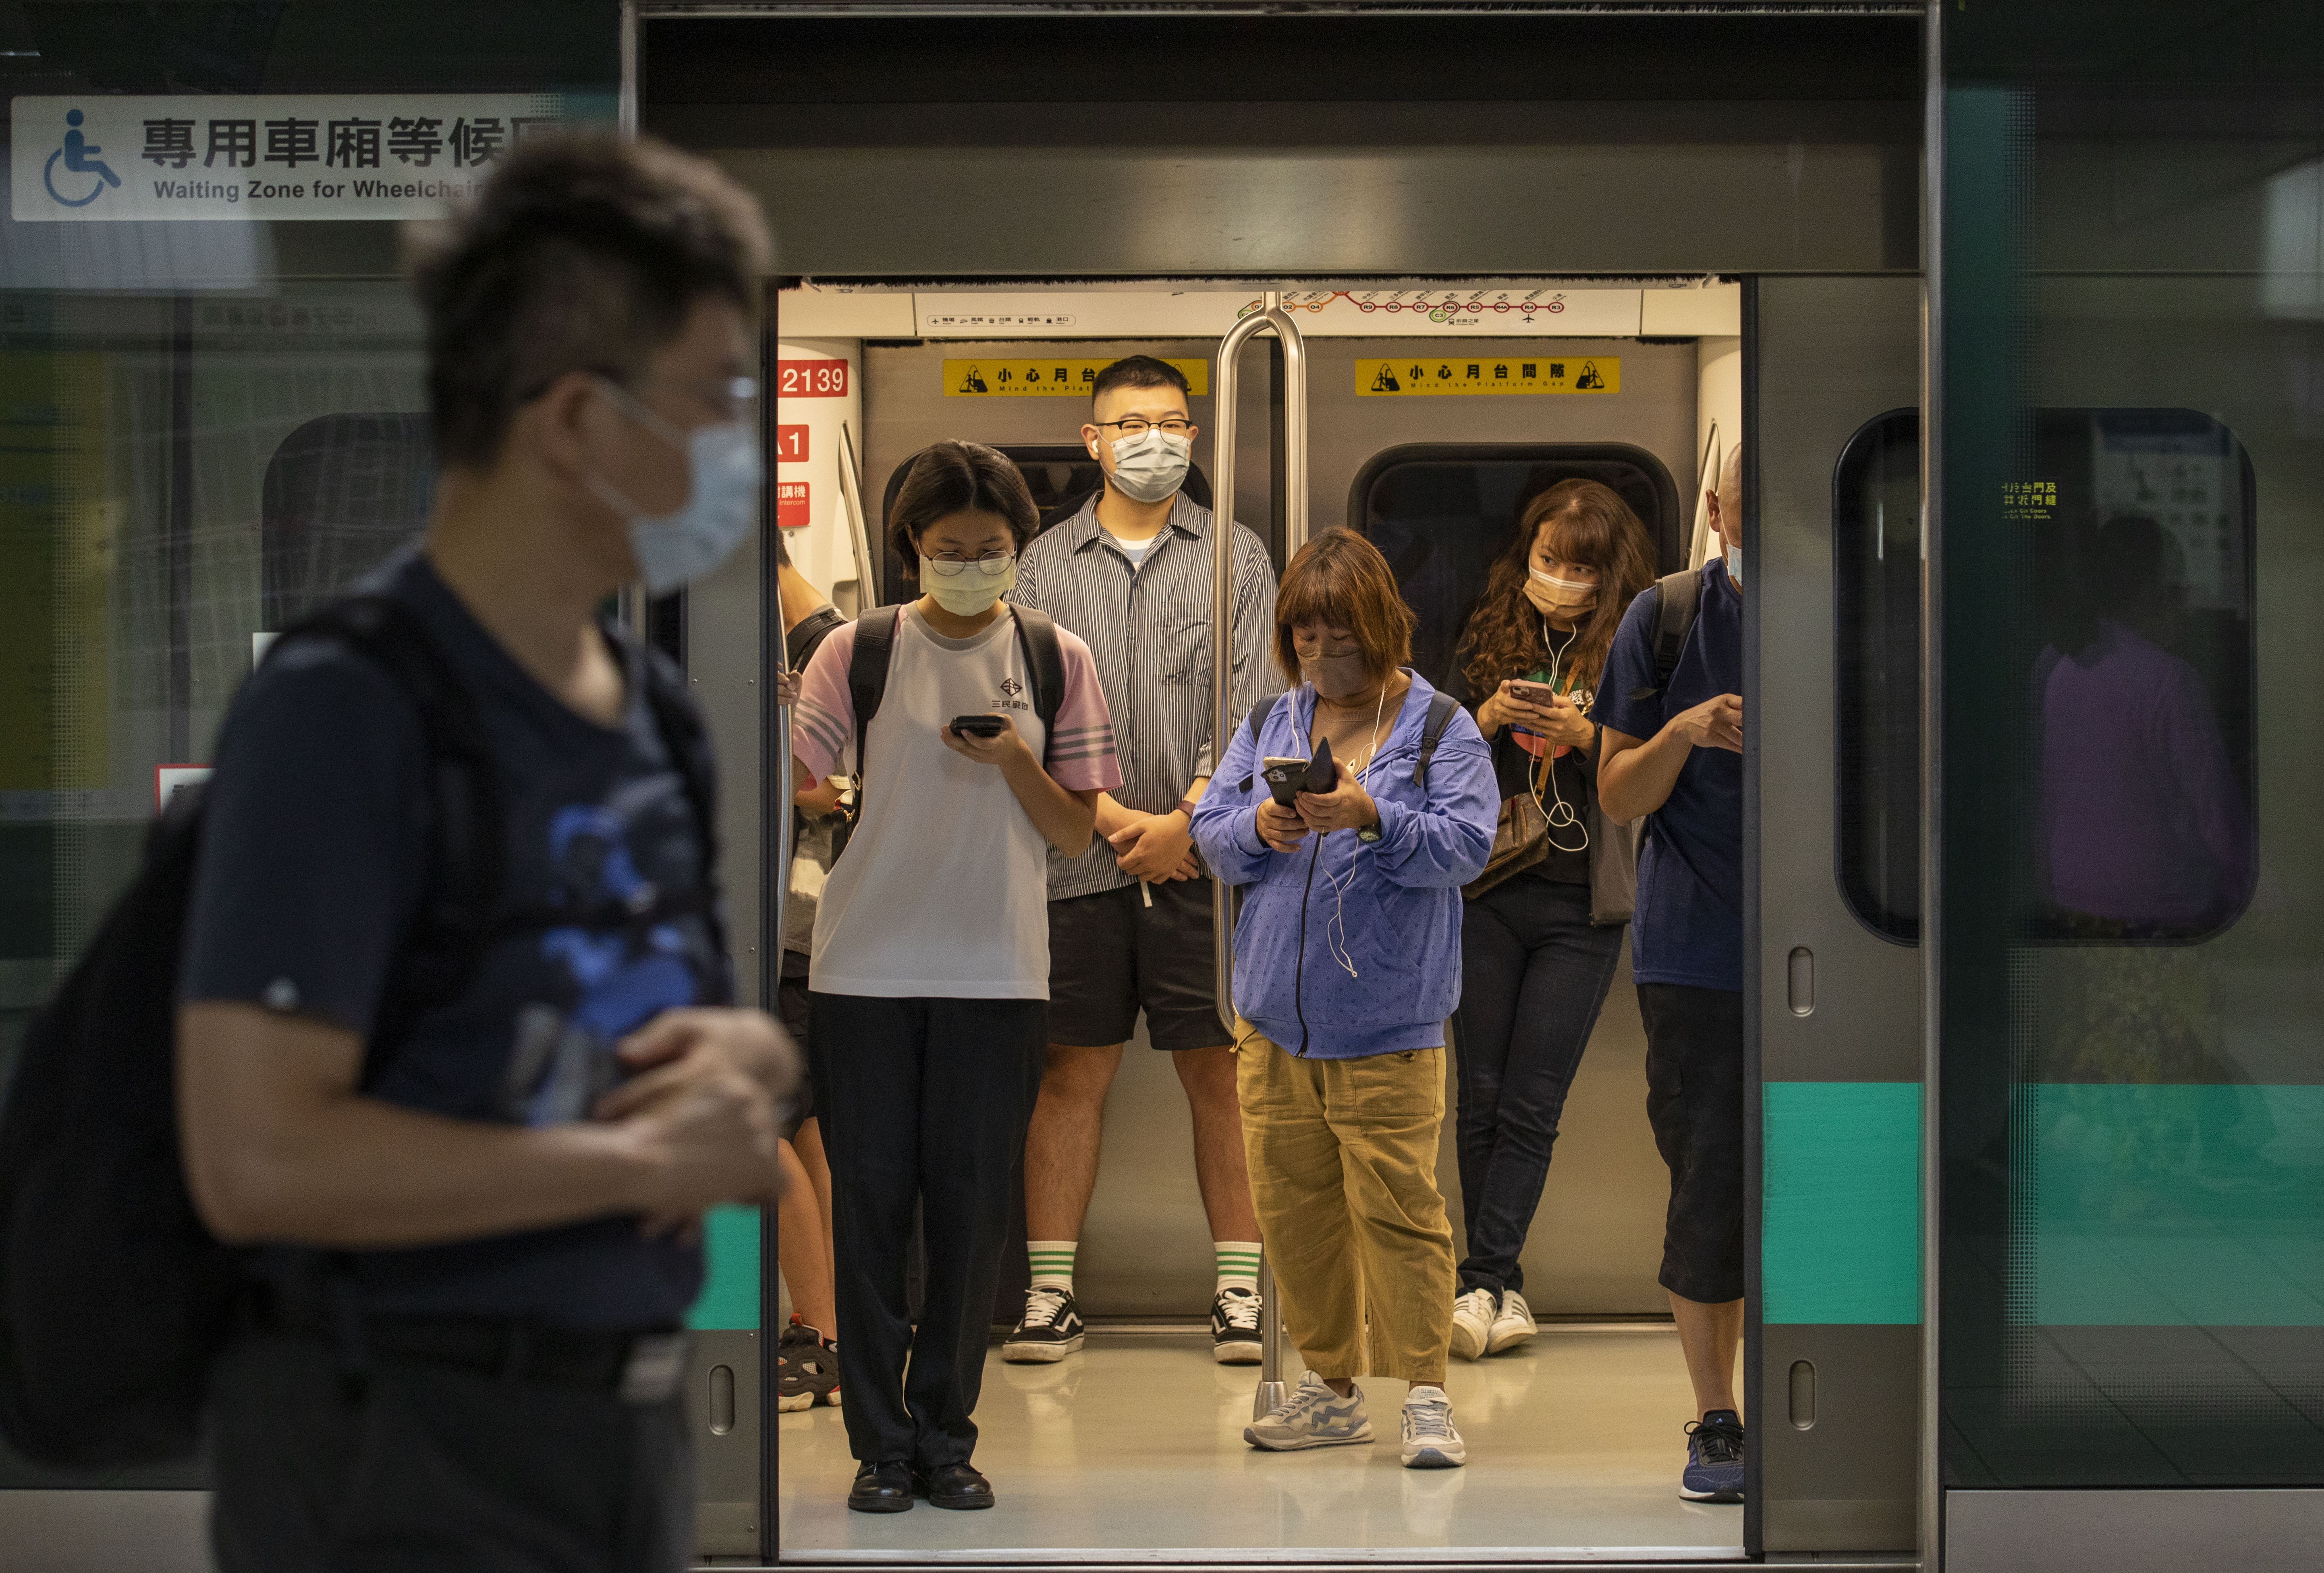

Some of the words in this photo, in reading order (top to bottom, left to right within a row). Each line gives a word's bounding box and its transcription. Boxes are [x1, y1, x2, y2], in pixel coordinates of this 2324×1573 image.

[154, 181, 239, 202] Waiting
[247, 181, 305, 198] Zone
[313, 180, 345, 198] for
[783, 368, 843, 392] 2139
[998, 368, 1095, 382] 小心月台
[1410, 364, 1564, 380] 小心月台間隙
[778, 432, 799, 455] 1
